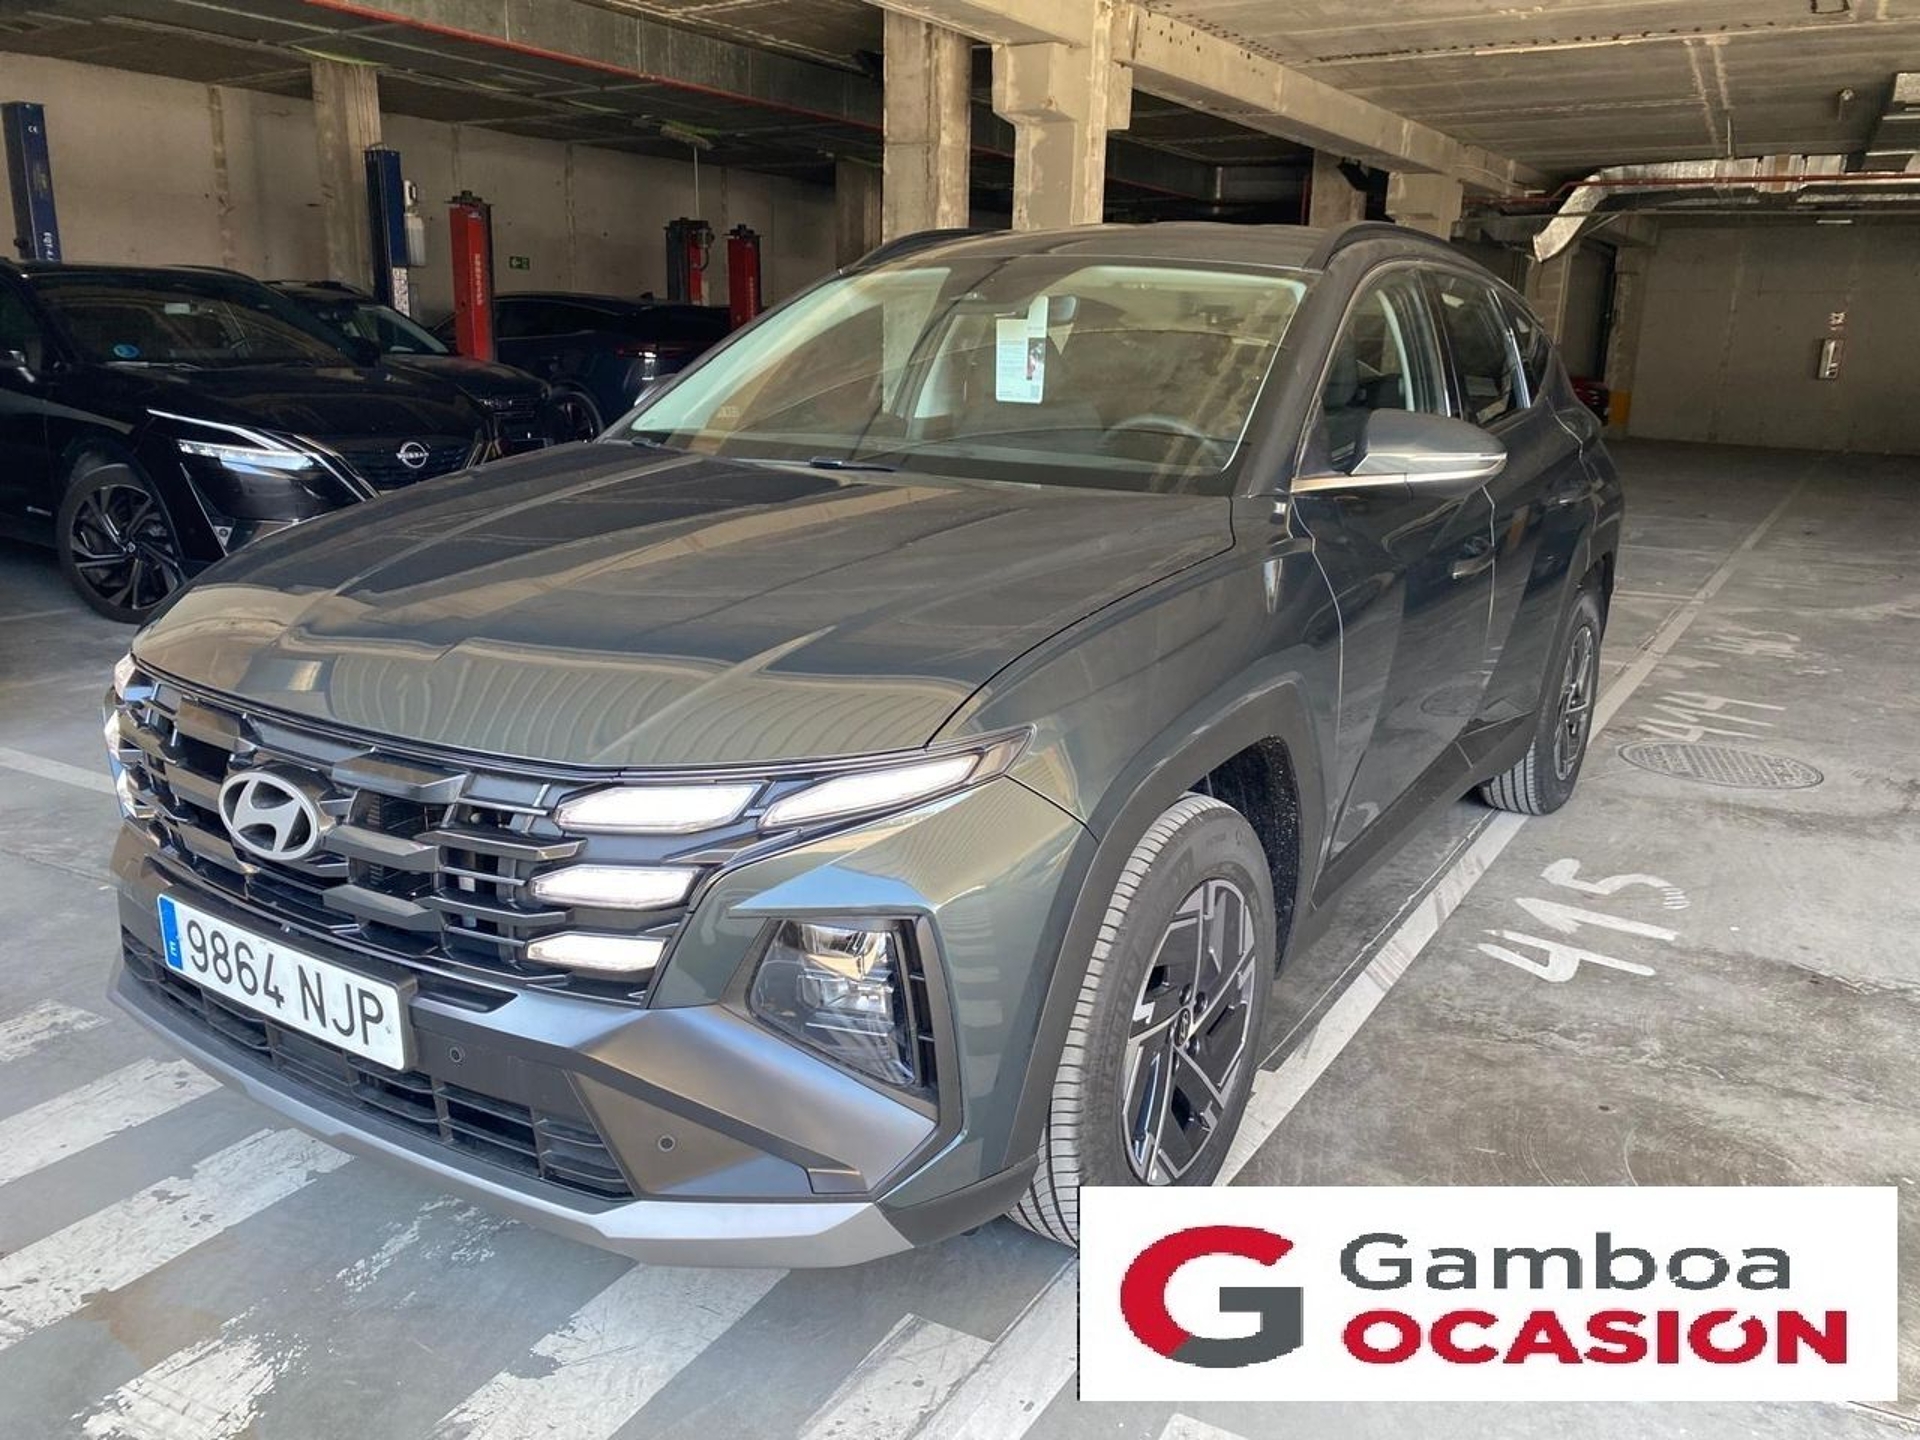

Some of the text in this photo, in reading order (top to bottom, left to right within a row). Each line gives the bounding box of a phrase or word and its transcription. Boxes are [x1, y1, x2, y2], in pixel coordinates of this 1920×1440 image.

[1637, 691, 1786, 742] 414
[187, 919, 384, 1045] 9864 NJP
[1477, 858, 1692, 982] 415
